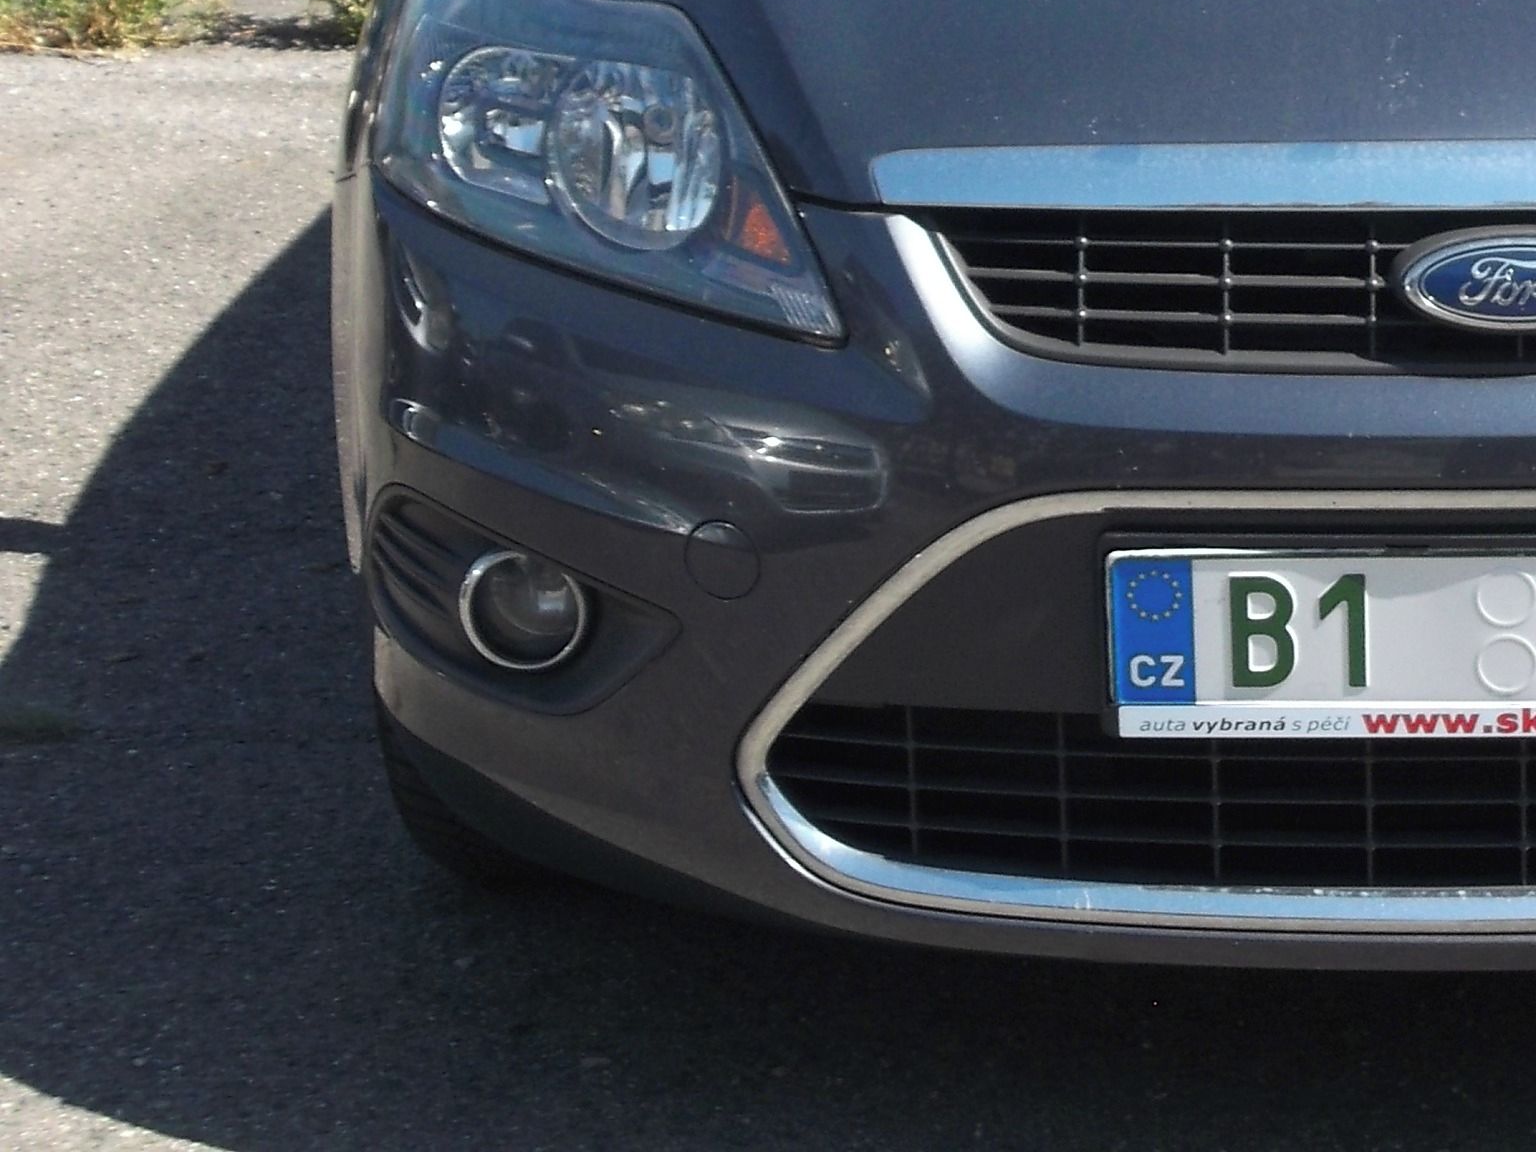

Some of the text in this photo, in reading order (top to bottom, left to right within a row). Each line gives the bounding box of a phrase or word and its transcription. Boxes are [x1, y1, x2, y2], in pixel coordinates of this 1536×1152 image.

[1229, 573, 1367, 688] B1
[1129, 655, 1185, 687] CZ
[1139, 718, 1186, 732] auta
[1192, 716, 1287, 734] vybraná
[1291, 720, 1302, 732] s
[1306, 715, 1351, 733] péčí
